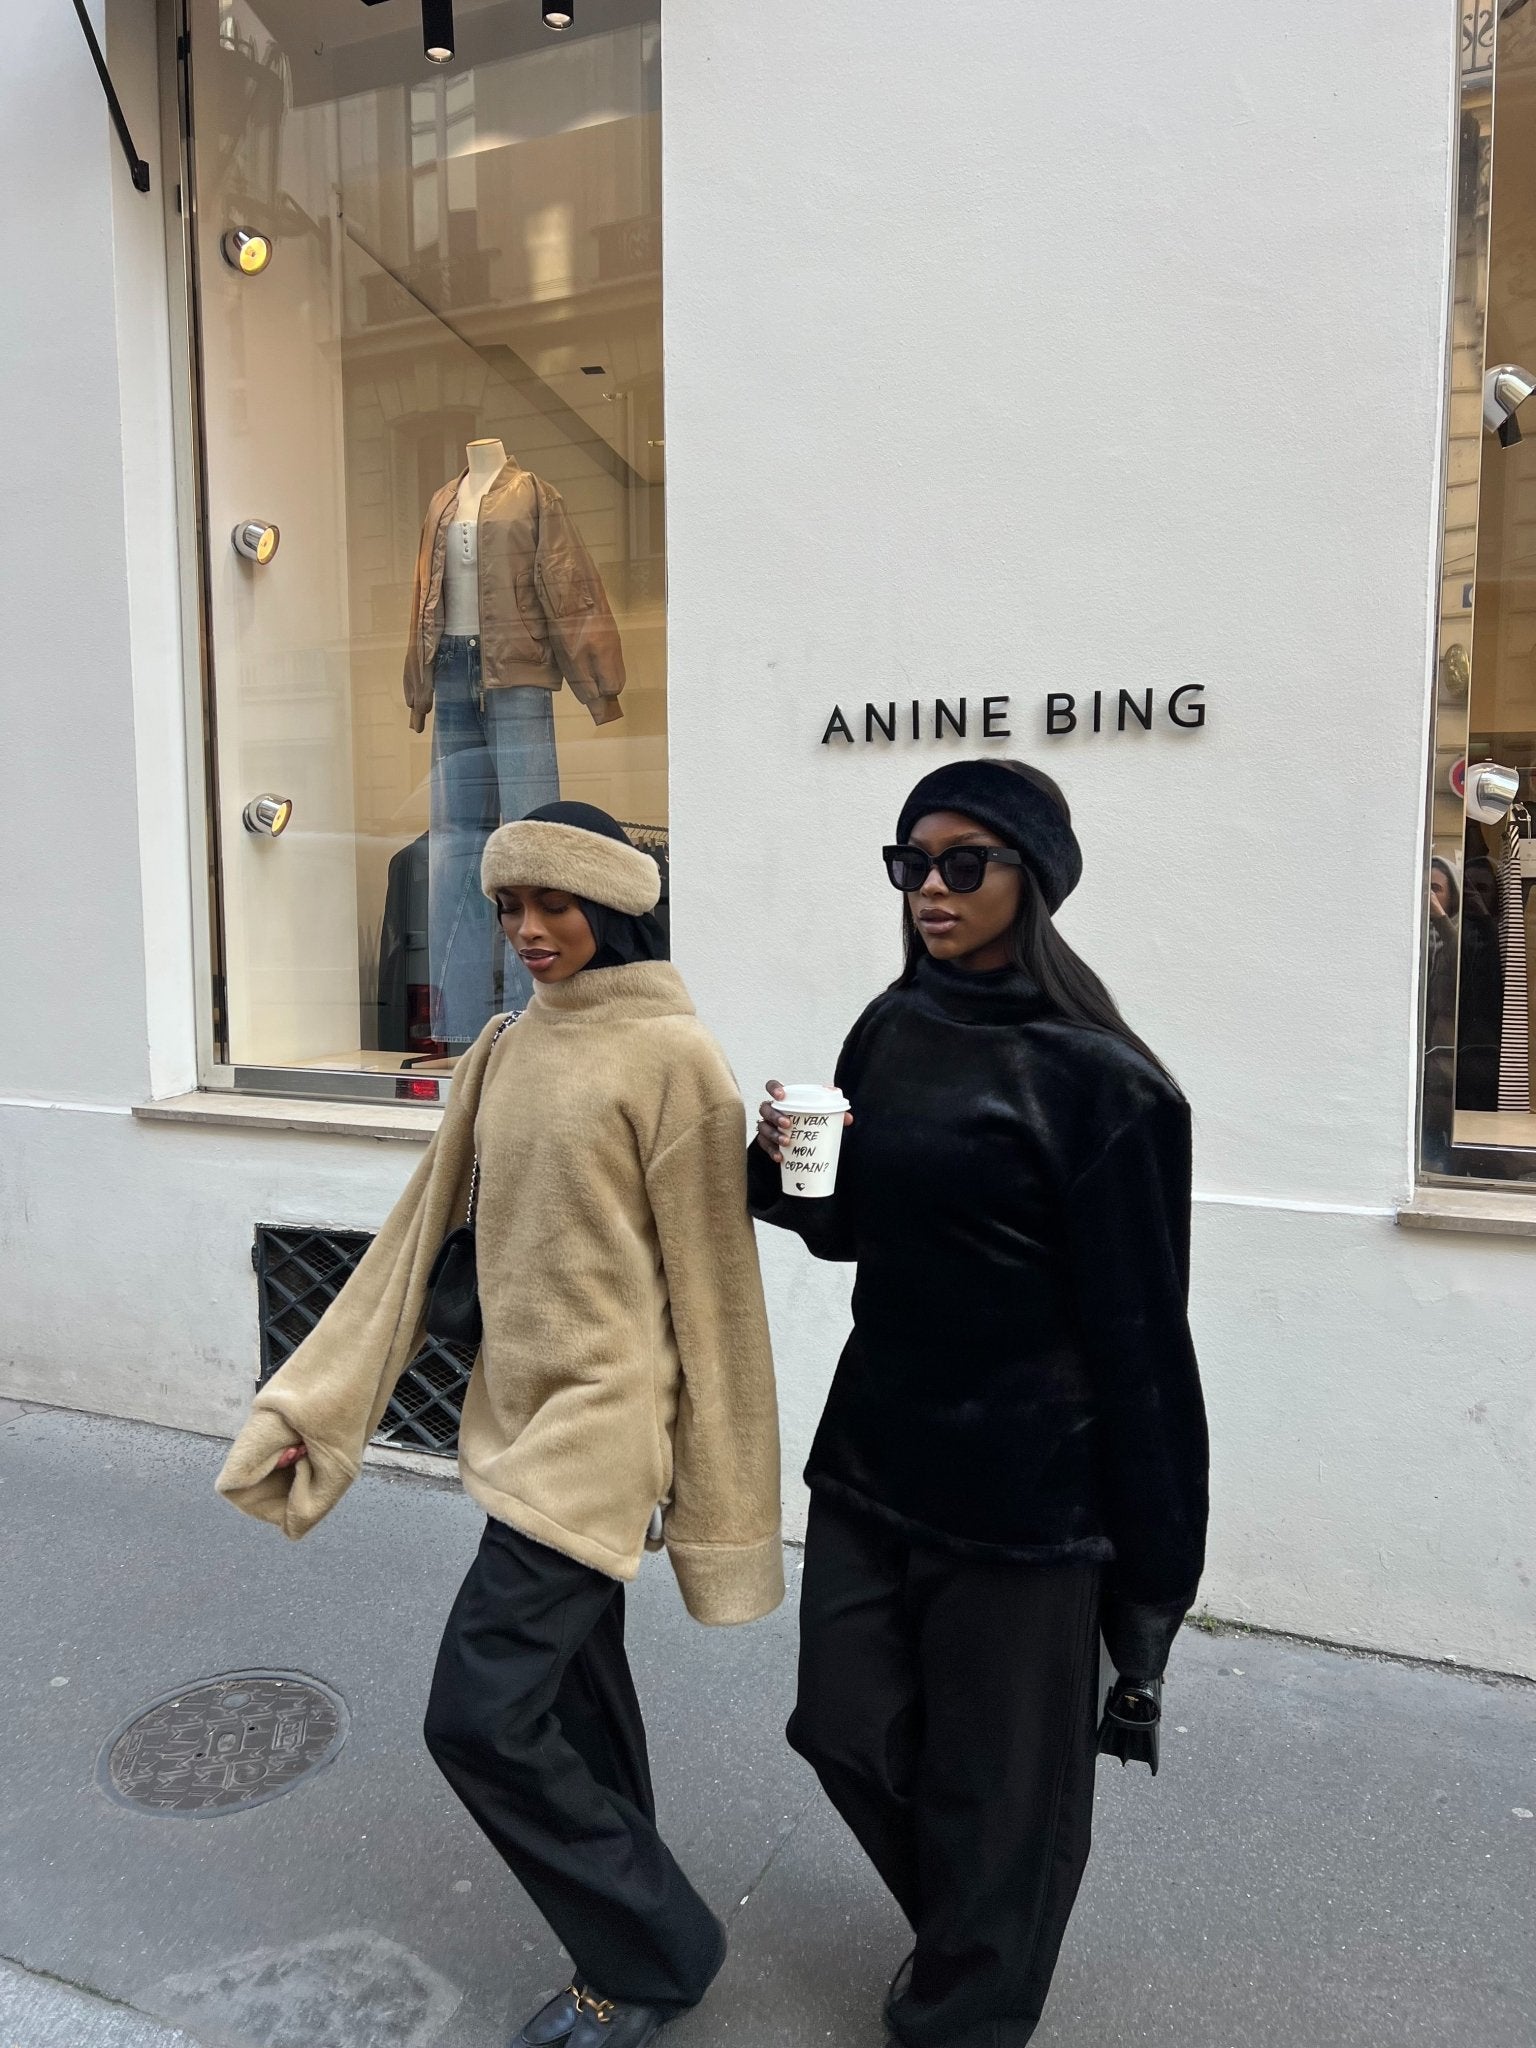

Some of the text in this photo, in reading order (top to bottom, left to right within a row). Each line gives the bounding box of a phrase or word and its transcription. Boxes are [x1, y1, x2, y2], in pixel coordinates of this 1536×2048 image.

[821, 683, 1206, 744] ANINE BING
[804, 1116, 829, 1126] VEUX
[790, 1127, 819, 1141] ÊTRE
[791, 1146, 816, 1158] MON
[785, 1160, 830, 1173] COPAIN?
